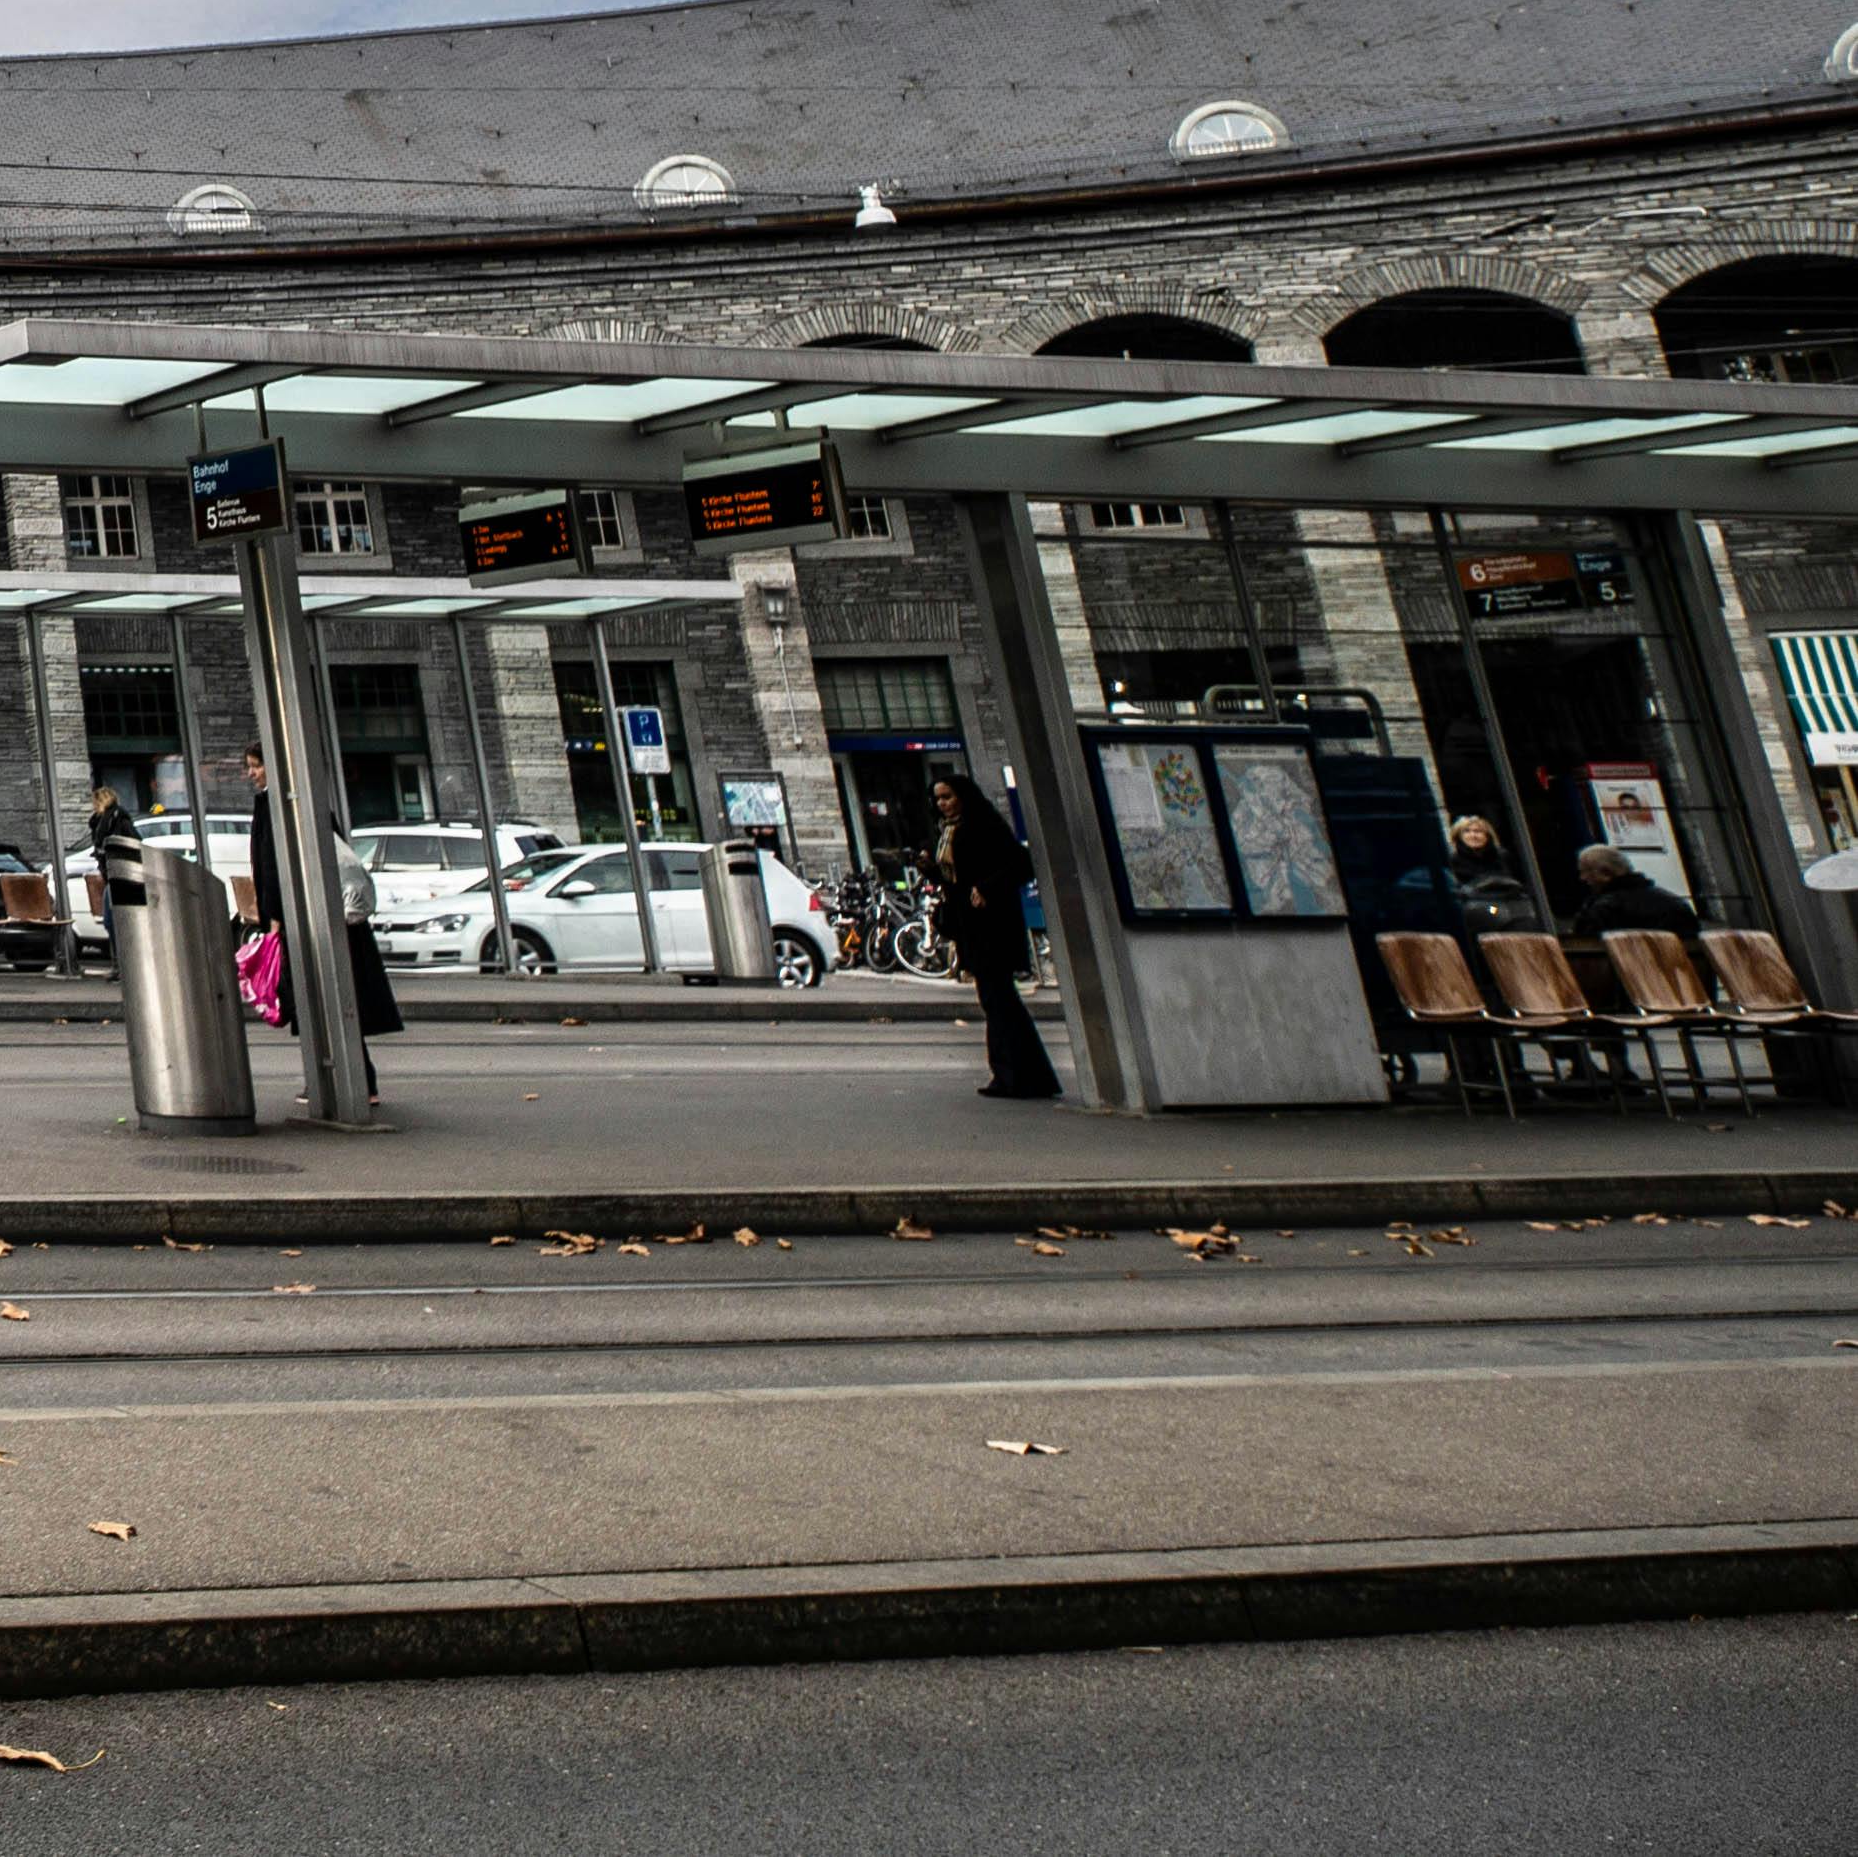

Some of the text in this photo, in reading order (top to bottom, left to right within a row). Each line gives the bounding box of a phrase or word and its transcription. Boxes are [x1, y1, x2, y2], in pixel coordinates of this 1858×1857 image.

[193, 459, 229, 479] Bahnhof
[194, 480, 217, 495] Enge
[207, 506, 218, 530] 5
[1469, 563, 1485, 582] 6
[1579, 560, 1612, 572] Enge
[1599, 581, 1616, 601] 5
[1478, 593, 1493, 612] 7
